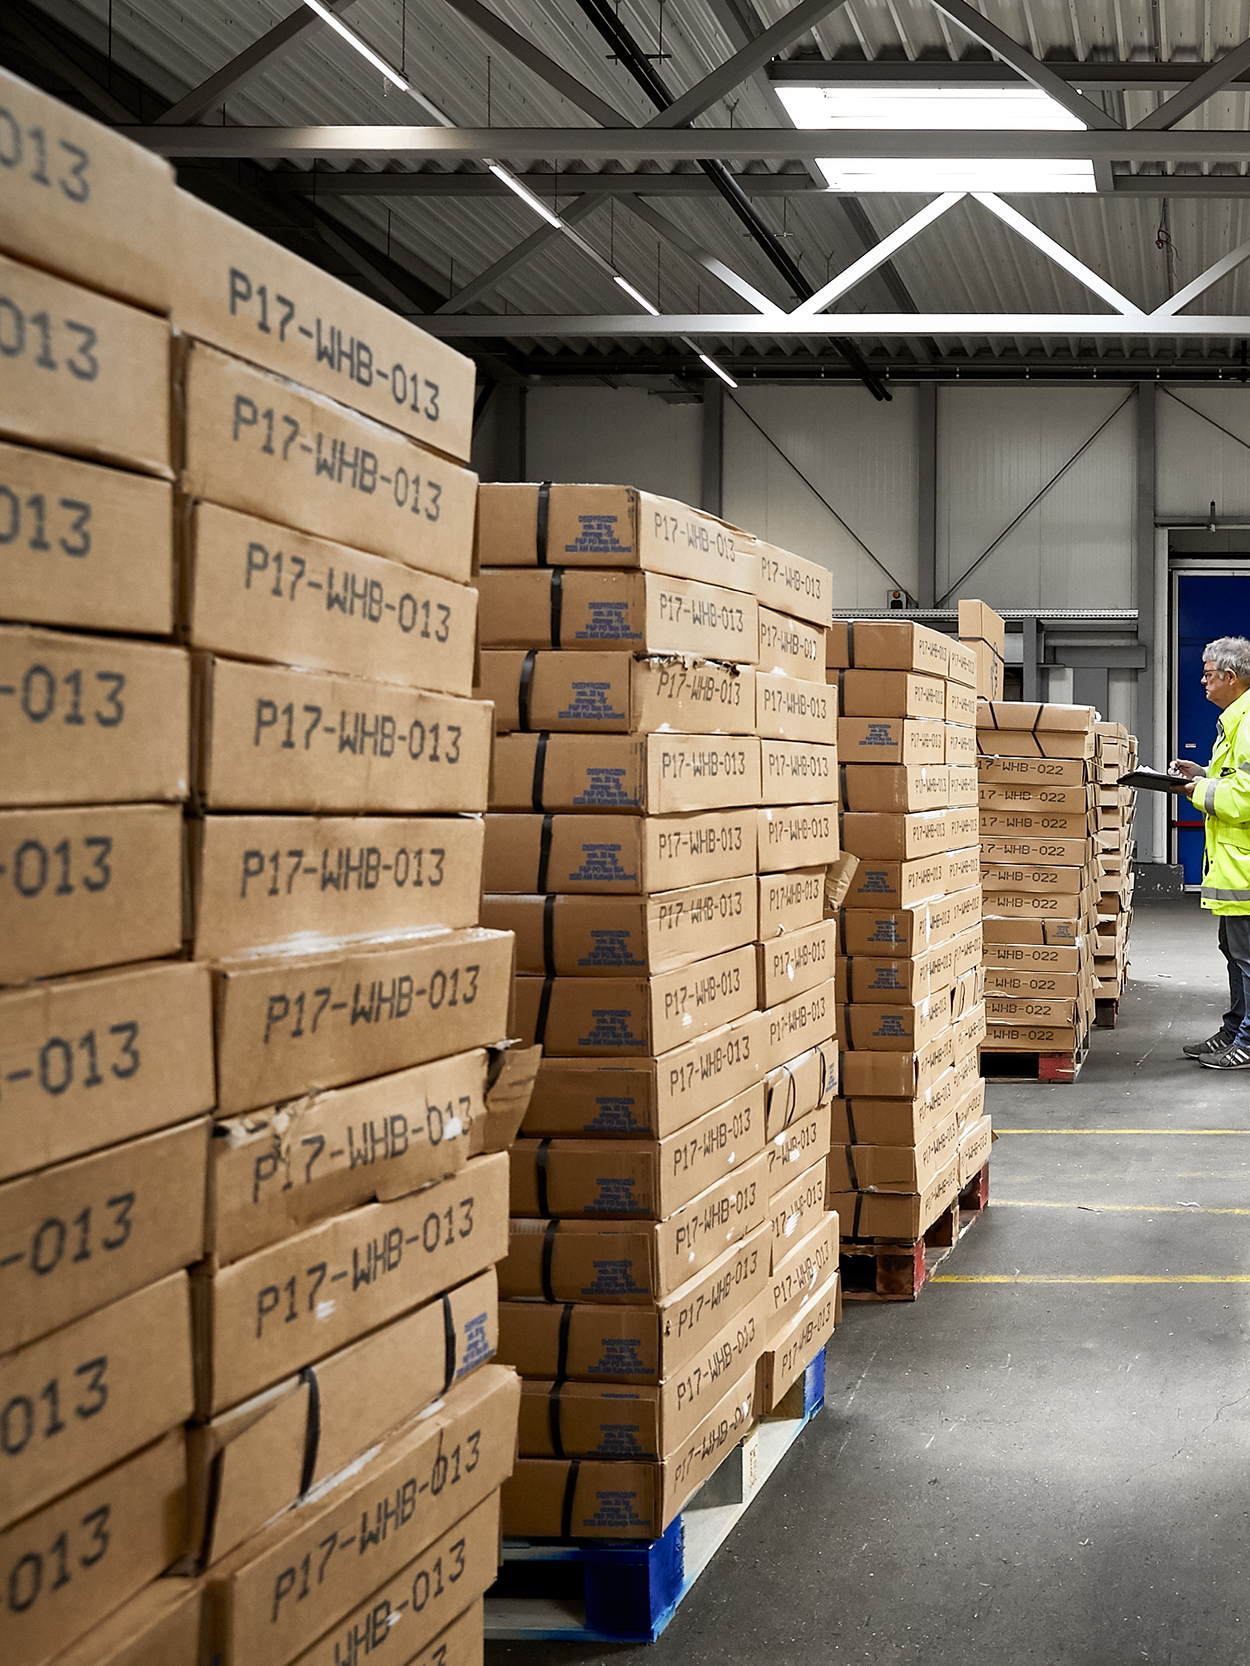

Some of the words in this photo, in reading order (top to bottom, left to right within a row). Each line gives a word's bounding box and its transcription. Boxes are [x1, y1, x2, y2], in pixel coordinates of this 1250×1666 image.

[230, 268, 440, 421] P17-WHB-013
[232, 395, 442, 521] P17-WHB-013
[654, 512, 736, 562] P17-WHB-013
[245, 542, 451, 642] P17-WHB-013
[762, 557, 820, 600] P17-WHB-013
[660, 594, 744, 633] P17-WHB-013
[657, 671, 741, 705] P17-WHB-013
[764, 689, 826, 719] P17-WHB-013
[254, 700, 462, 764] P17-WHB-013
[662, 752, 745, 779] P17-WHB-013
[769, 754, 828, 777] P17-WHB-013
[978, 760, 1064, 776] 17-WHB-022
[980, 790, 1066, 802] 17-WHB-022
[659, 827, 742, 859] P17-WHB-013
[768, 818, 829, 844] P17-WHB-013
[981, 817, 1068, 828] 17-WHB-022
[241, 848, 446, 898] P17-WHB-013
[769, 880, 819, 911] P17-WHB-013
[981, 870, 1058, 883] 7-WHB-022
[659, 892, 742, 931] P17-WHB-013
[982, 896, 1058, 910] 7-WHB-022
[264, 965, 480, 1044] P17-WHB-013
[664, 968, 740, 1019] P17-WHB-013
[769, 998, 826, 1045] P17-WHB-013
[670, 1036, 750, 1096] P17-WHB-013
[674, 1109, 750, 1176] P17-WHB-013
[676, 1182, 756, 1255] P17-WHB-013
[256, 1198, 475, 1338] P17-WHB-013
[774, 1240, 830, 1308] P17-WHB-013
[678, 1251, 758, 1337] P17-WHB-013
[677, 1318, 755, 1410] P17-WHB-013
[271, 1430, 481, 1624] P17-WHB-013
